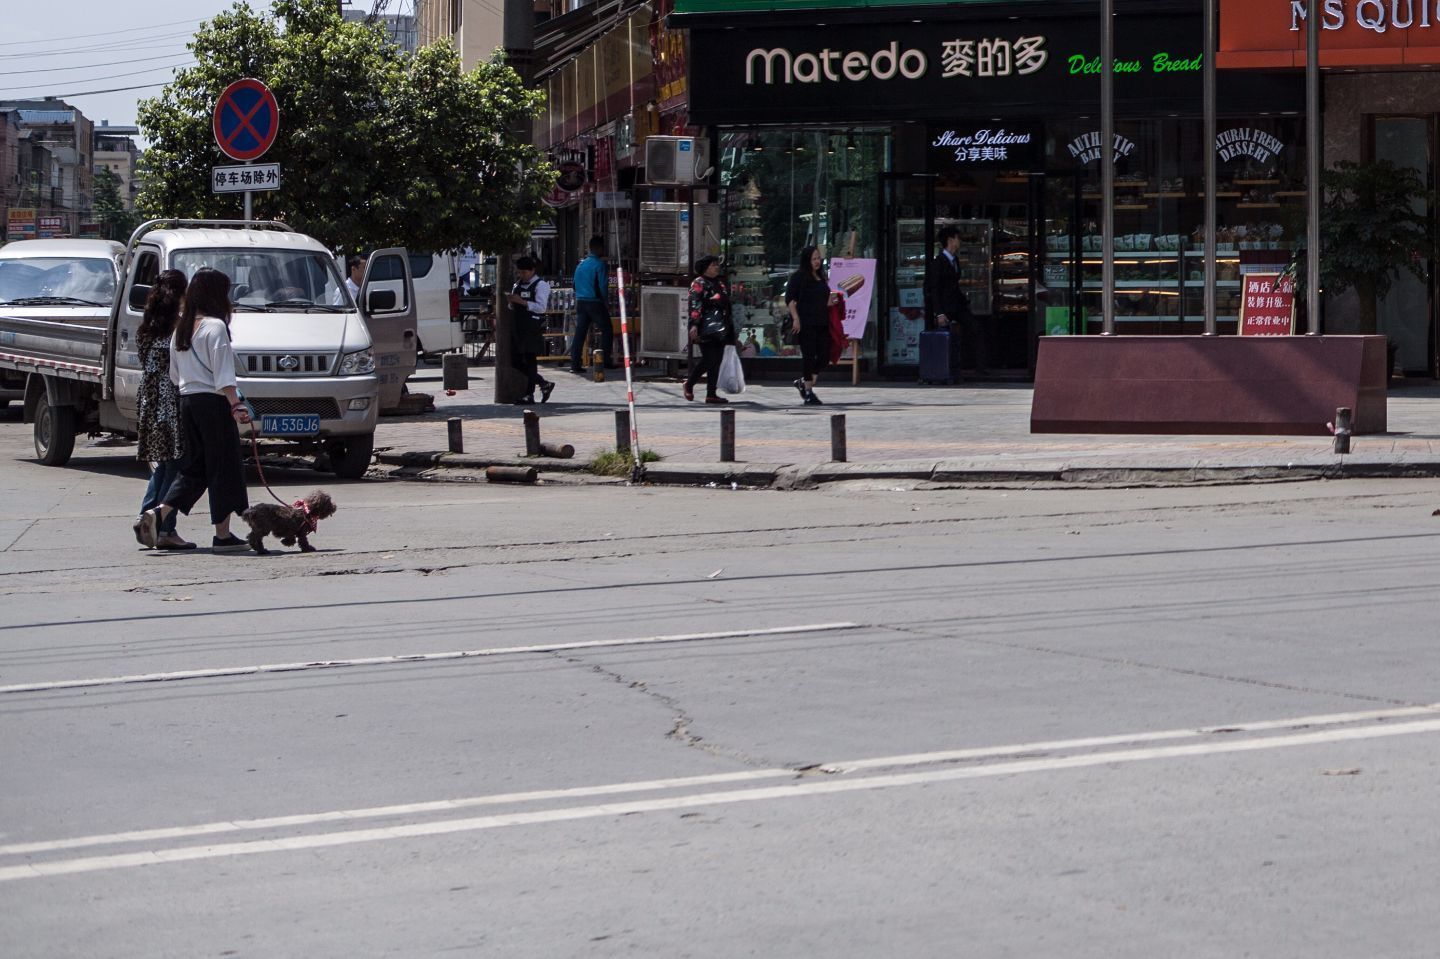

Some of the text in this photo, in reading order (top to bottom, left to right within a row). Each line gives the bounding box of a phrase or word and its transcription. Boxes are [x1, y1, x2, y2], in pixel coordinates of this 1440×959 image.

[745, 35, 1048, 84] Matedo 麥的多
[1152, 52, 1203, 73] Bread
[932, 128, 1031, 147] Share Delicious
[1066, 131, 1135, 158] AUTHTIC
[1216, 127, 1284, 156] ATURAL FRESH
[954, 145, 1008, 161] 分享美味
[1080, 147, 1122, 166] BAKY
[1218, 141, 1271, 164] DESSERT
[215, 169, 278, 187] 停车场除外
